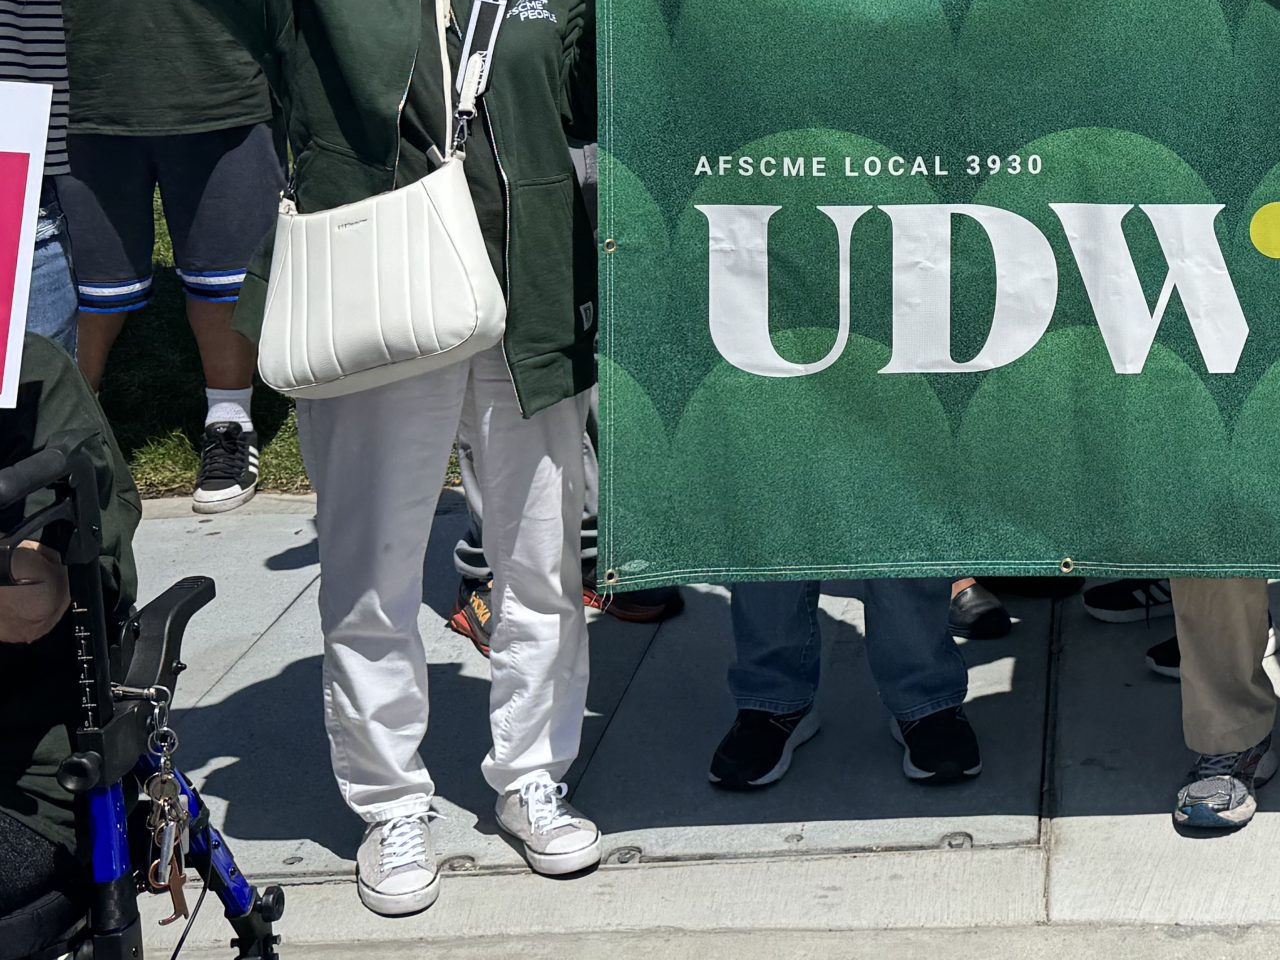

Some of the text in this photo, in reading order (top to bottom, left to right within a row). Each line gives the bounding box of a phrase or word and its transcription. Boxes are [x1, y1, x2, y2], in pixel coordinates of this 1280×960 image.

[694, 154, 1043, 177] AFSCME LOCAL 3930
[693, 202, 1250, 377] UDW
